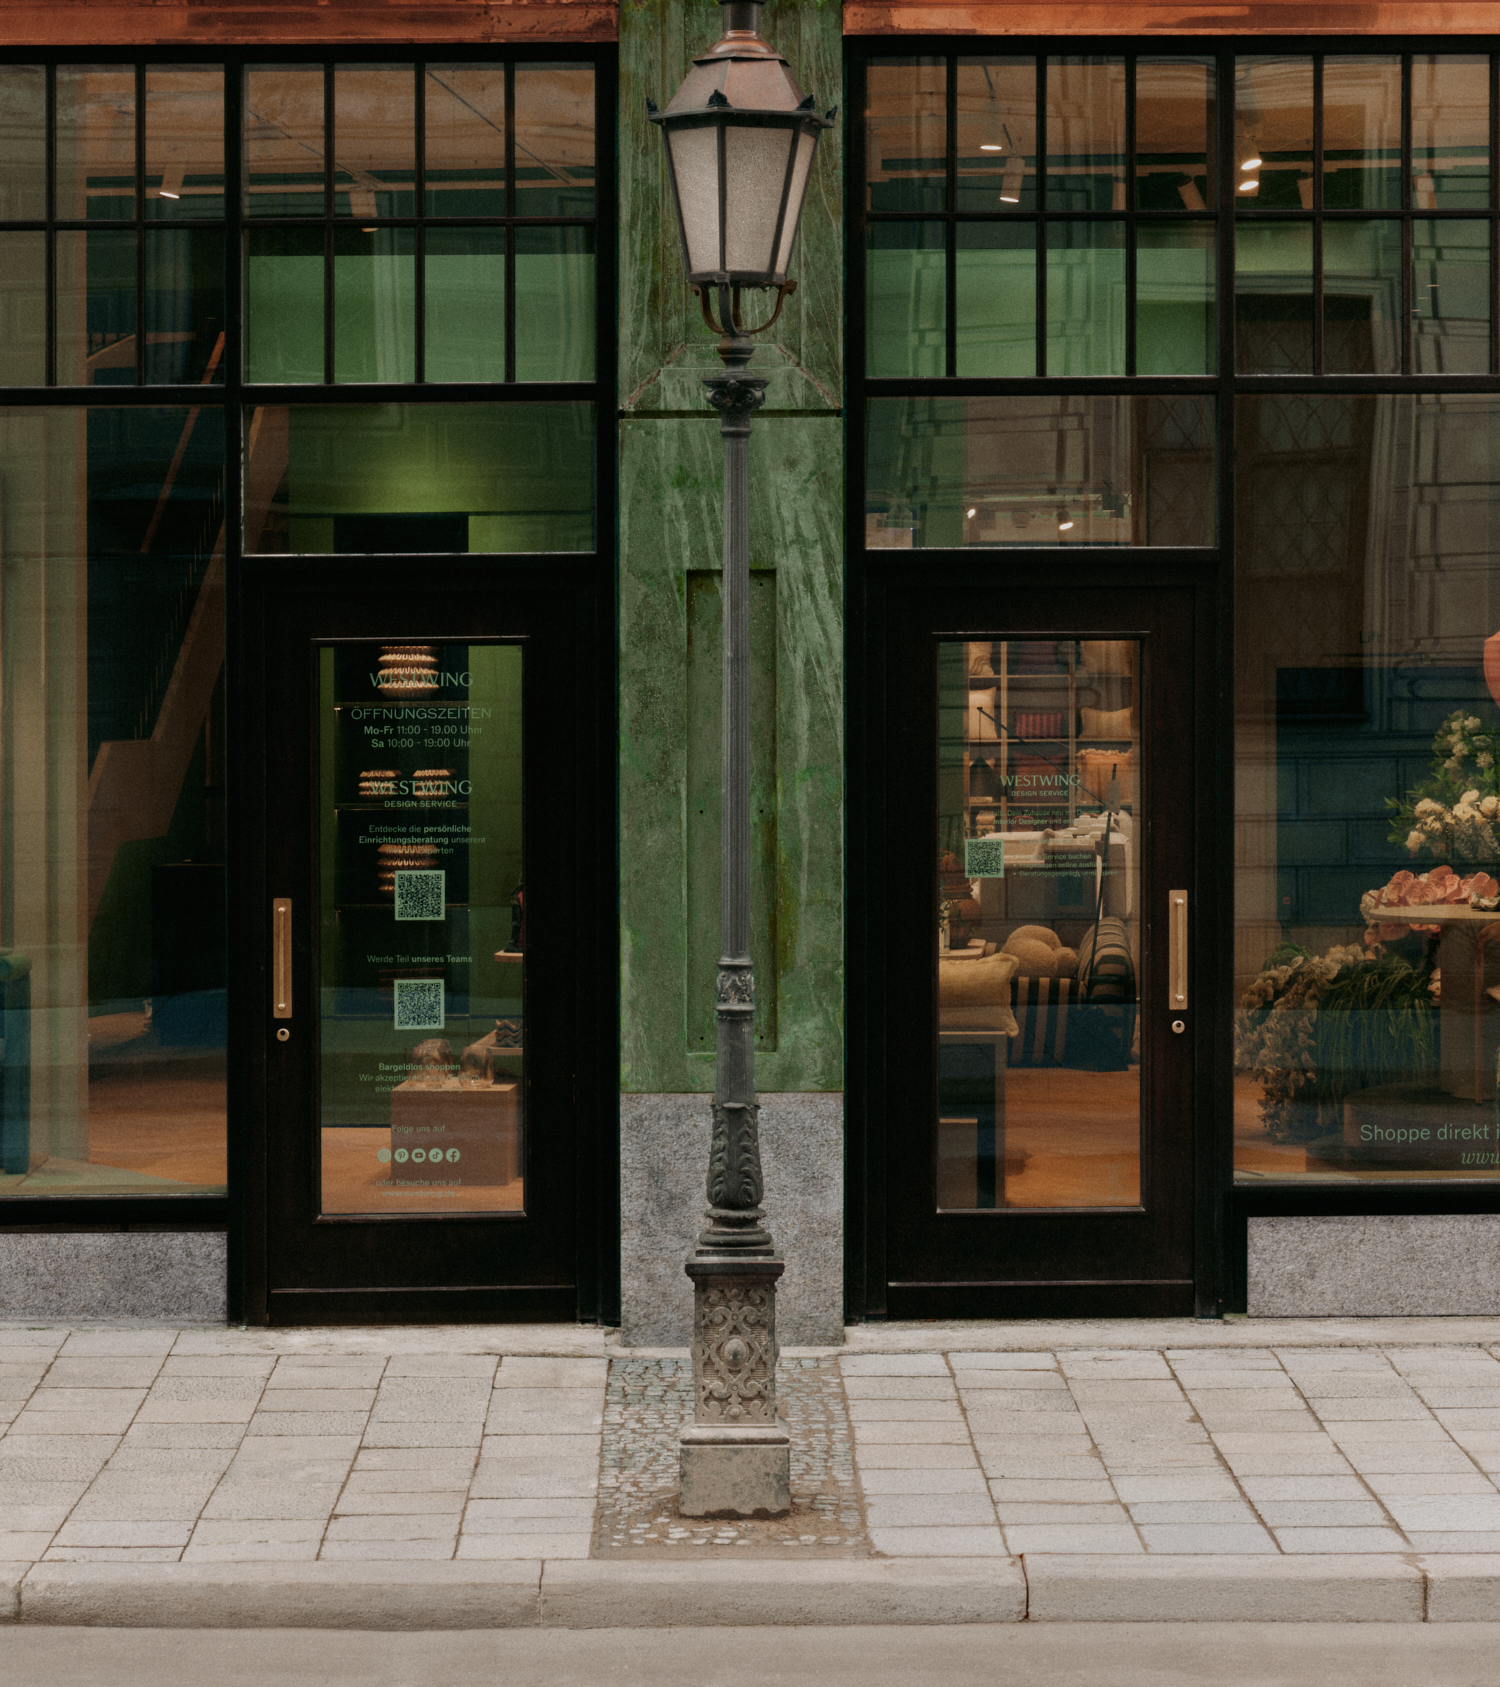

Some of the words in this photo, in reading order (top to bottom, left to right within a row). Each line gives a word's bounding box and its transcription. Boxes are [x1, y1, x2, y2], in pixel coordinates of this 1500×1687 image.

[369, 672, 474, 687] WESTWING
[363, 725, 395, 735] Mo-Fr
[396, 725, 421, 735] 11:00
[371, 739, 385, 748] Sa
[387, 738, 414, 748] 10:00
[424, 738, 451, 748] 19:00
[453, 738, 471, 748] Uhr
[1000, 774, 1081, 787] WESTWING
[369, 780, 473, 795] WESTWING
[1039, 789, 1069, 797] SERVICE
[384, 800, 418, 808] DESIGN
[419, 800, 458, 808] SERVICE
[368, 825, 407, 833] Entdecke
[408, 825, 422, 833] die
[423, 824, 472, 834] persönliche
[358, 835, 449, 845] Einrichtungsberatung
[366, 954, 395, 963] Werde
[395, 954, 410, 963] Teil
[411, 955, 445, 963] unseres
[445, 954, 473, 963] Teams
[378, 1063, 423, 1072] Bargeldlos
[425, 1063, 461, 1072] shoppen
[358, 1073, 374, 1082] Wir
[391, 1124, 414, 1134] Folge
[416, 1125, 431, 1133] uns
[432, 1124, 446, 1133] auf
[1360, 1124, 1431, 1143] Shoppe
[1437, 1123, 1490, 1140] direkt
